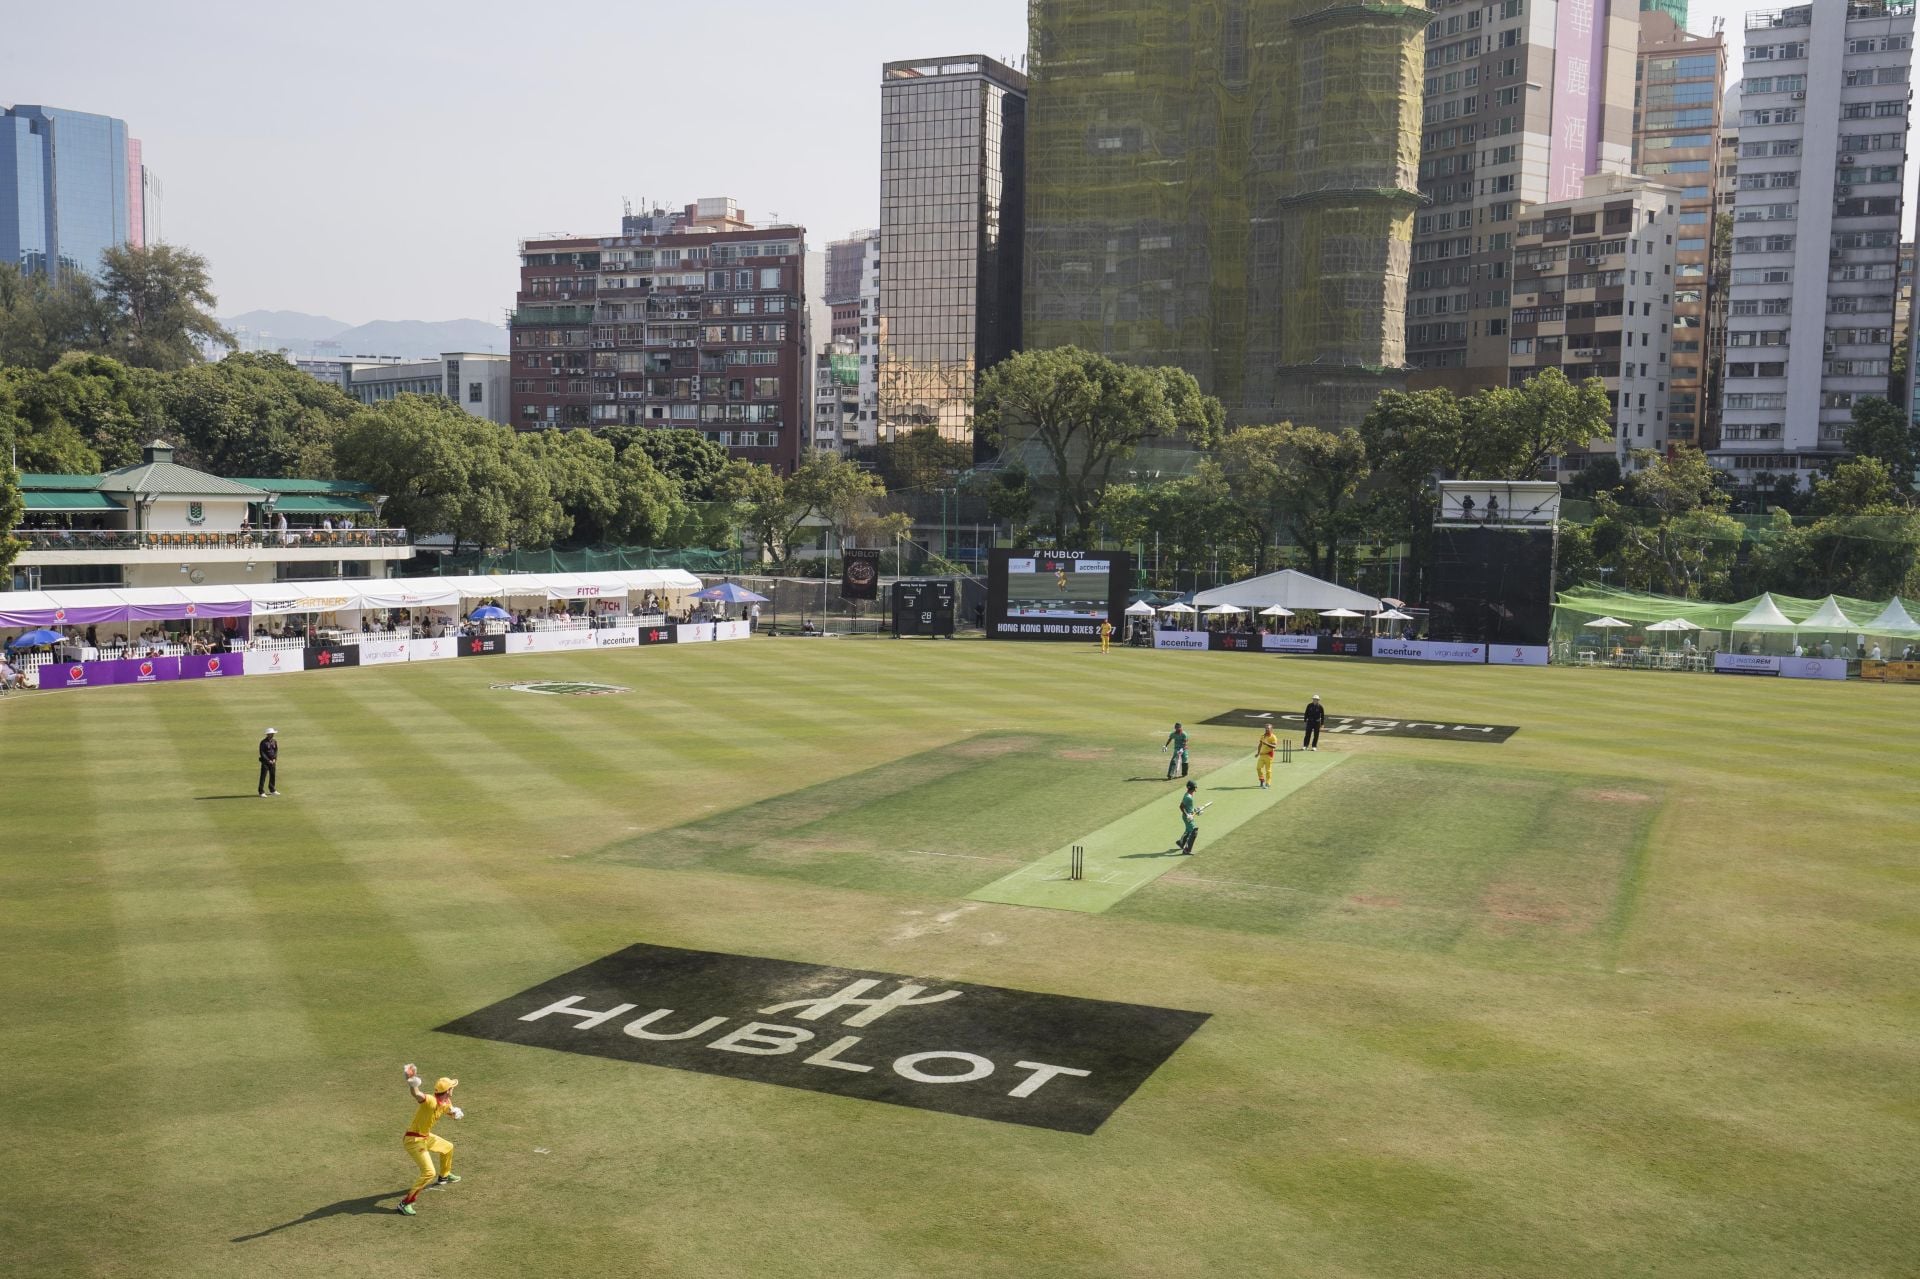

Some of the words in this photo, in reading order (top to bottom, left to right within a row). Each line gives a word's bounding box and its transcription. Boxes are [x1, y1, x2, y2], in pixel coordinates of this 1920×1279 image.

[845, 550, 880, 558] HUBLOT
[1044, 551, 1085, 559] HUBLOT
[577, 587, 600, 596] FITCH
[603, 601, 620, 611] TCH
[921, 611, 932, 619] 28
[997, 623, 1019, 632] HONG
[1020, 624, 1041, 633] KONG
[1043, 624, 1070, 634] WORLD
[1072, 625, 1094, 635] SIXES
[1095, 626, 1117, 635] 27
[603, 637, 636, 645] accenture
[1161, 639, 1203, 648] accenture
[1377, 648, 1422, 657] accenture
[517, 994, 1092, 1099] HUBLOT
